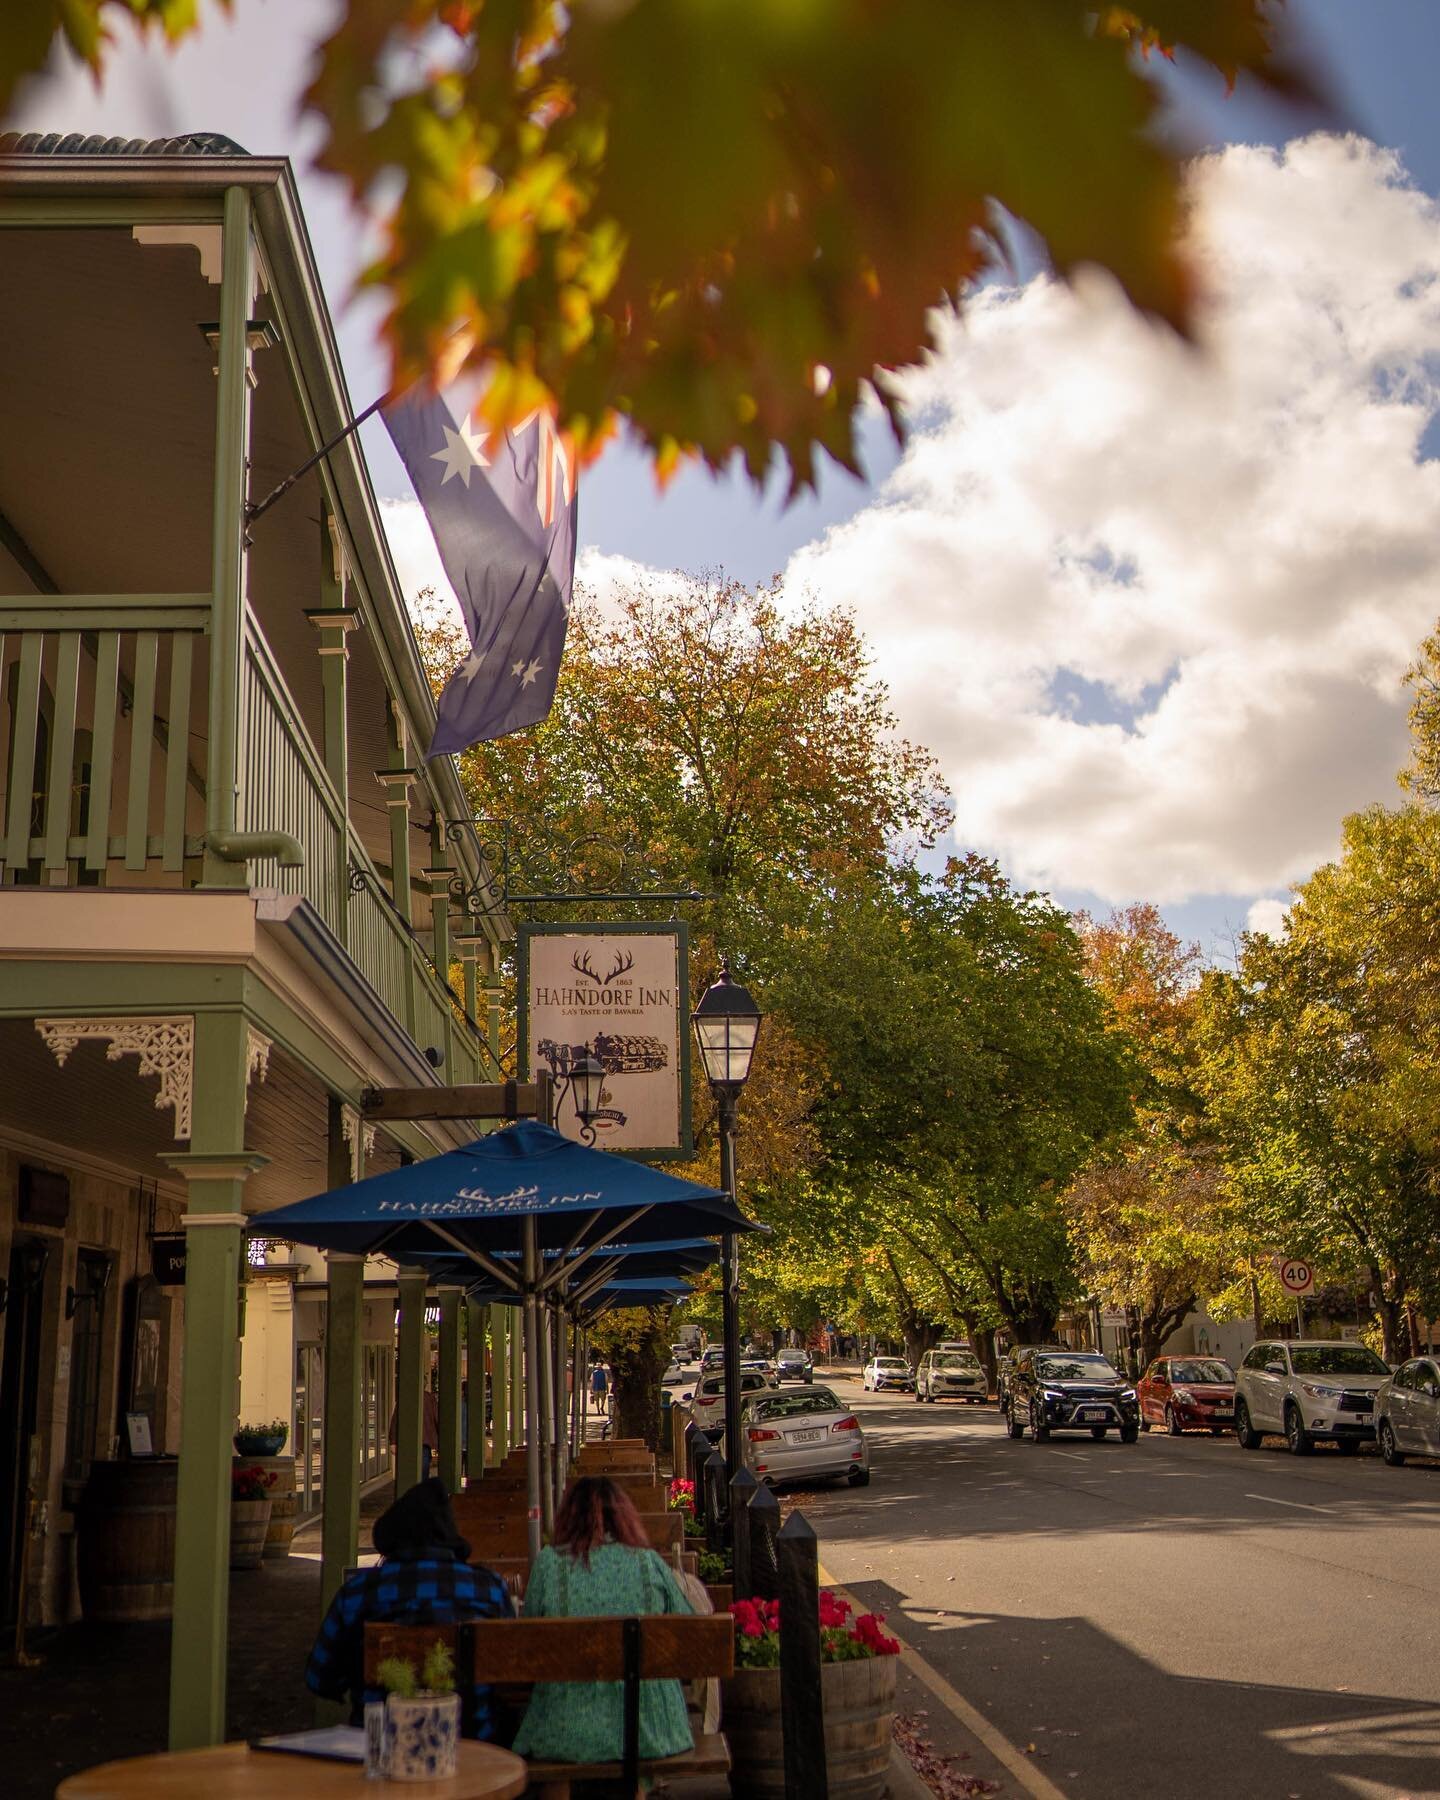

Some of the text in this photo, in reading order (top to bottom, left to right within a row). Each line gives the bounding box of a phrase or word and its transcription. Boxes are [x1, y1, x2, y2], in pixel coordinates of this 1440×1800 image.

[536, 987, 671, 1006] HAHNDORF INN
[580, 1008, 601, 1016] TASTE
[602, 1008, 612, 1016] OF
[550, 1191, 603, 1205] INN
[1286, 1267, 1307, 1281] 40
